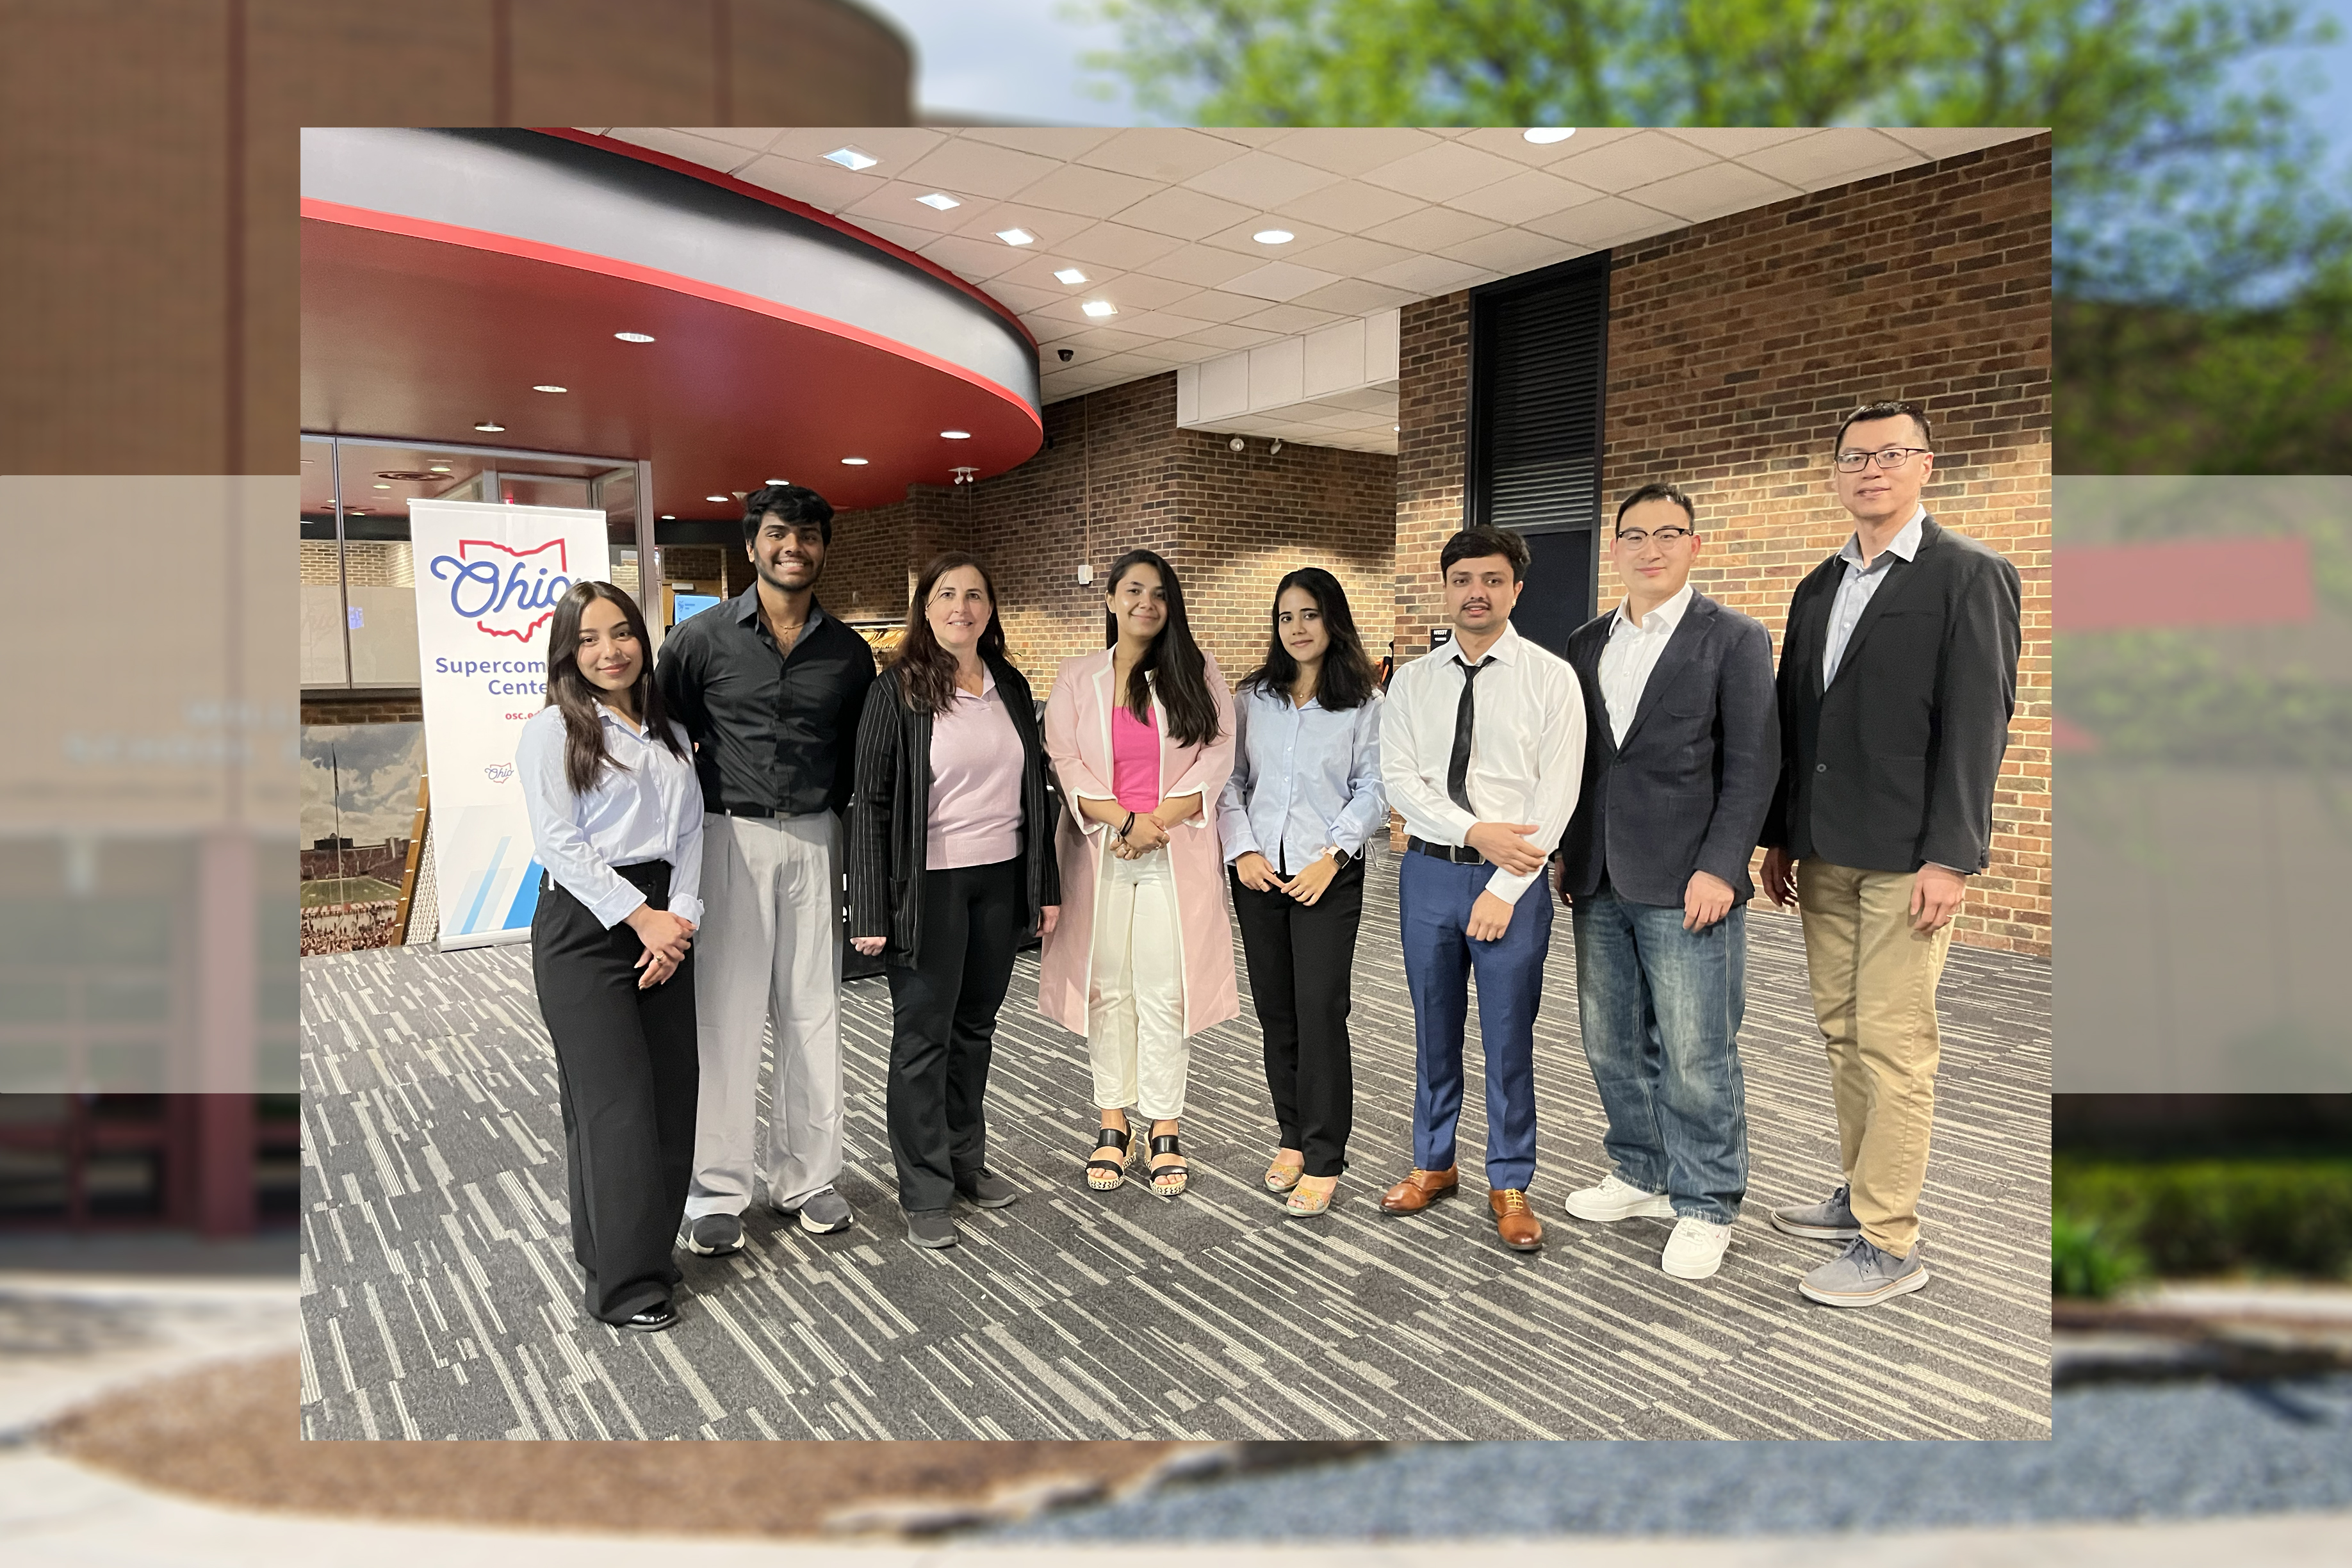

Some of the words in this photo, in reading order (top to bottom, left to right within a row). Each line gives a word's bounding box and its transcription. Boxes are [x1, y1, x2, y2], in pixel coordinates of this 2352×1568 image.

[430, 555, 582, 617] Ohio
[436, 657, 546, 677] Supercom
[488, 680, 548, 695] Cente
[505, 710, 541, 720] osc.e
[484, 768, 514, 780] Ohio
